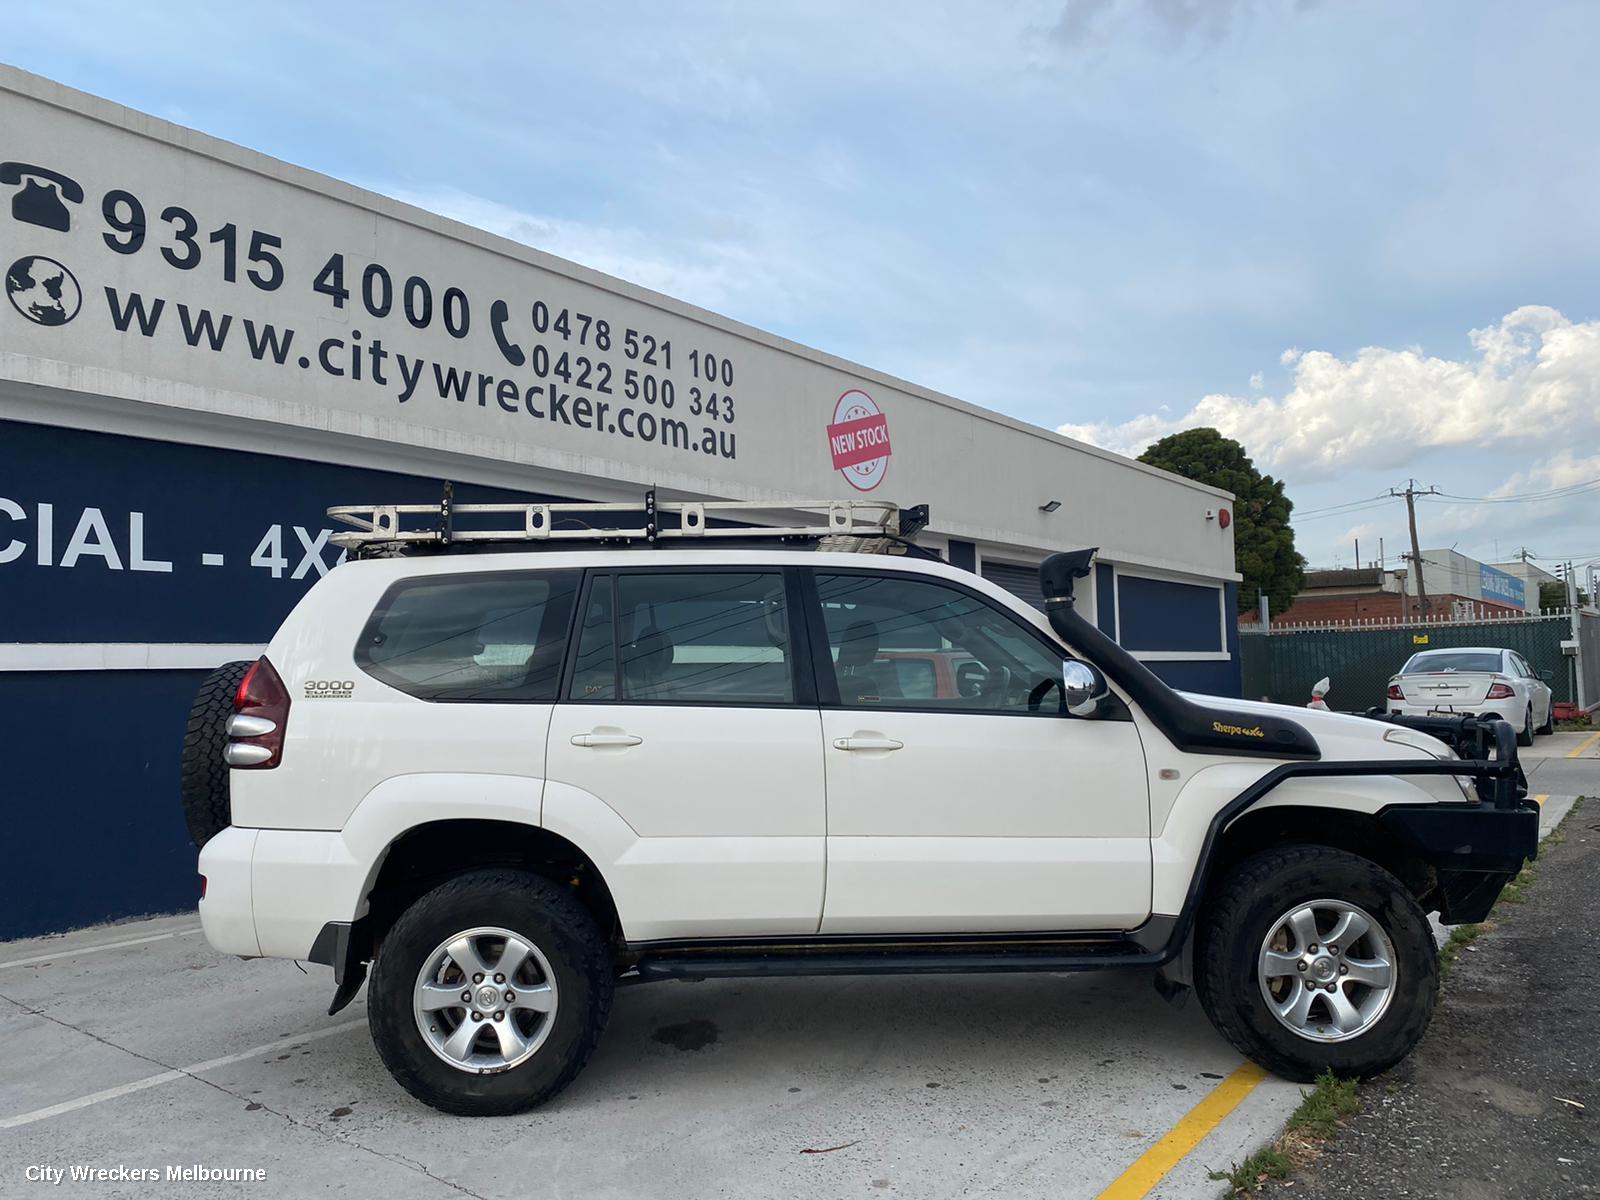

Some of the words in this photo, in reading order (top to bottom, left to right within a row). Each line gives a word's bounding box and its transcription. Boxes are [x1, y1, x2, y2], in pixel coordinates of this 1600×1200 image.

[102, 189, 284, 291] 9315
[313, 253, 470, 339] 4000
[104, 286, 736, 460] www.citywrecker.com.au
[532, 300, 611, 351] 0478
[624, 328, 671, 369] 521
[689, 349, 734, 387] 100
[532, 344, 612, 394] 0422
[624, 368, 675, 409] 500
[689, 386, 735, 424] 343
[831, 432, 856, 456] NEW
[856, 424, 888, 450] STOCK
[250, 524, 348, 579] 4X
[304, 680, 355, 690] 3000
[1213, 721, 1242, 735] Sherpa
